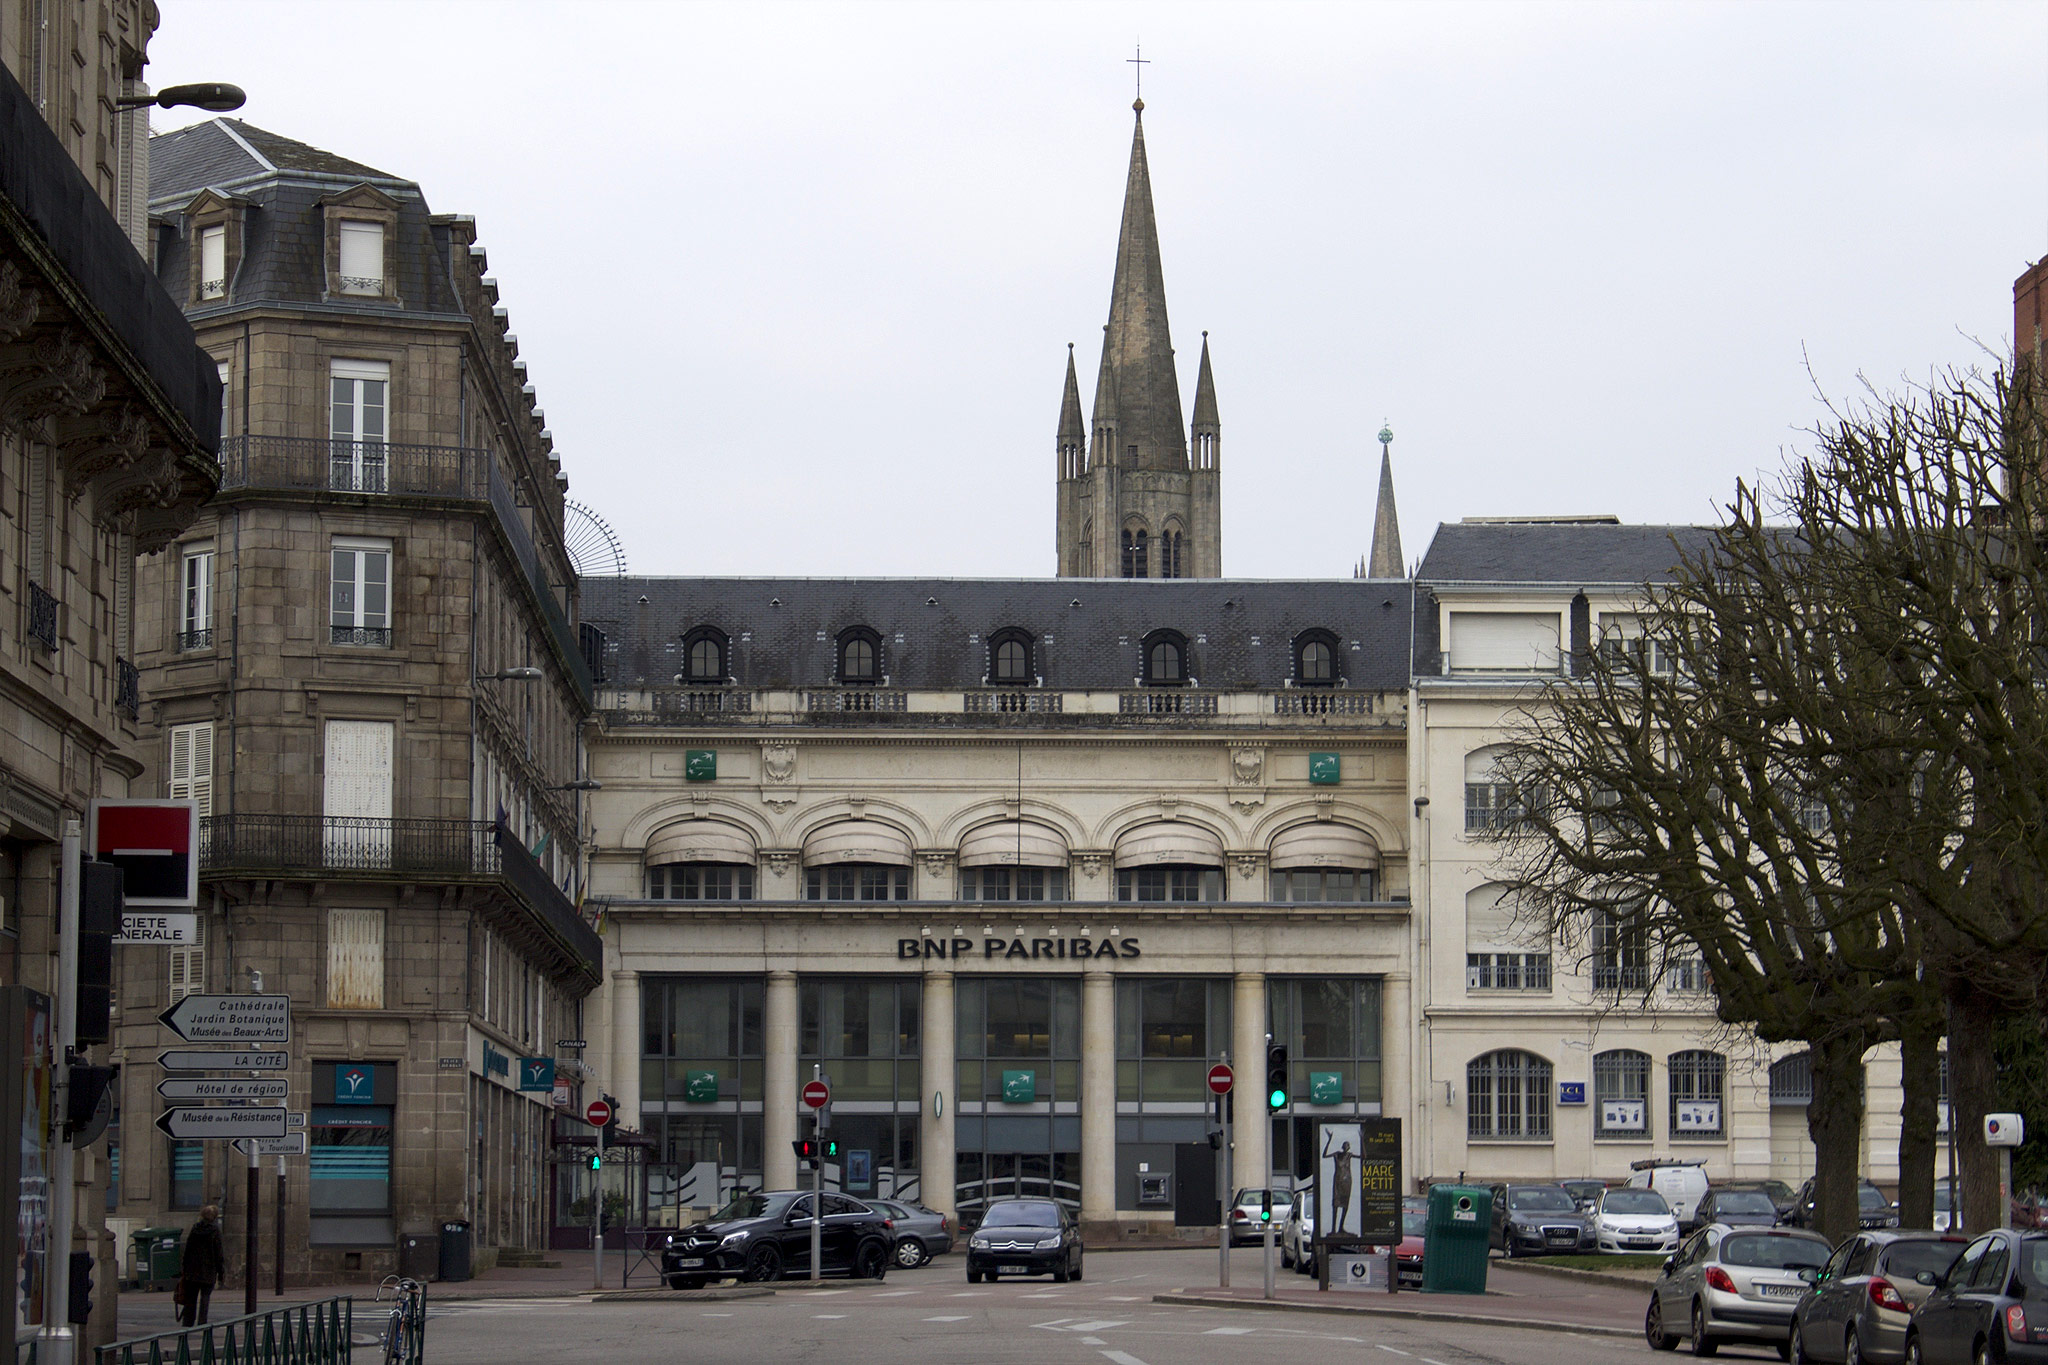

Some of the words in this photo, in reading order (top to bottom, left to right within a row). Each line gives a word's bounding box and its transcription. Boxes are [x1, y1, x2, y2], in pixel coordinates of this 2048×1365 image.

[122, 917, 167, 928] CIETE
[112, 929, 183, 940] NERALE
[898, 938, 974, 959] BNP
[984, 938, 1141, 959] PARIBAS
[219, 1001, 285, 1011] Cathédrale
[190, 1014, 226, 1024] Jardin
[229, 1014, 285, 1026] Botanique
[190, 1027, 221, 1037] Musée
[233, 1027, 284, 1037] Beaux-Arts
[234, 1056, 248, 1066] LA
[255, 1056, 282, 1066] CITÉ
[196, 1084, 226, 1094] Hôtel
[230, 1084, 243, 1093] de
[248, 1084, 283, 1095] région
[1561, 1086, 1581, 1094] LCL
[181, 1112, 213, 1122] Musée
[230, 1112, 282, 1122] Résistance
[1362, 1165, 1395, 1177] MARC
[1362, 1177, 1395, 1190] PETIT
